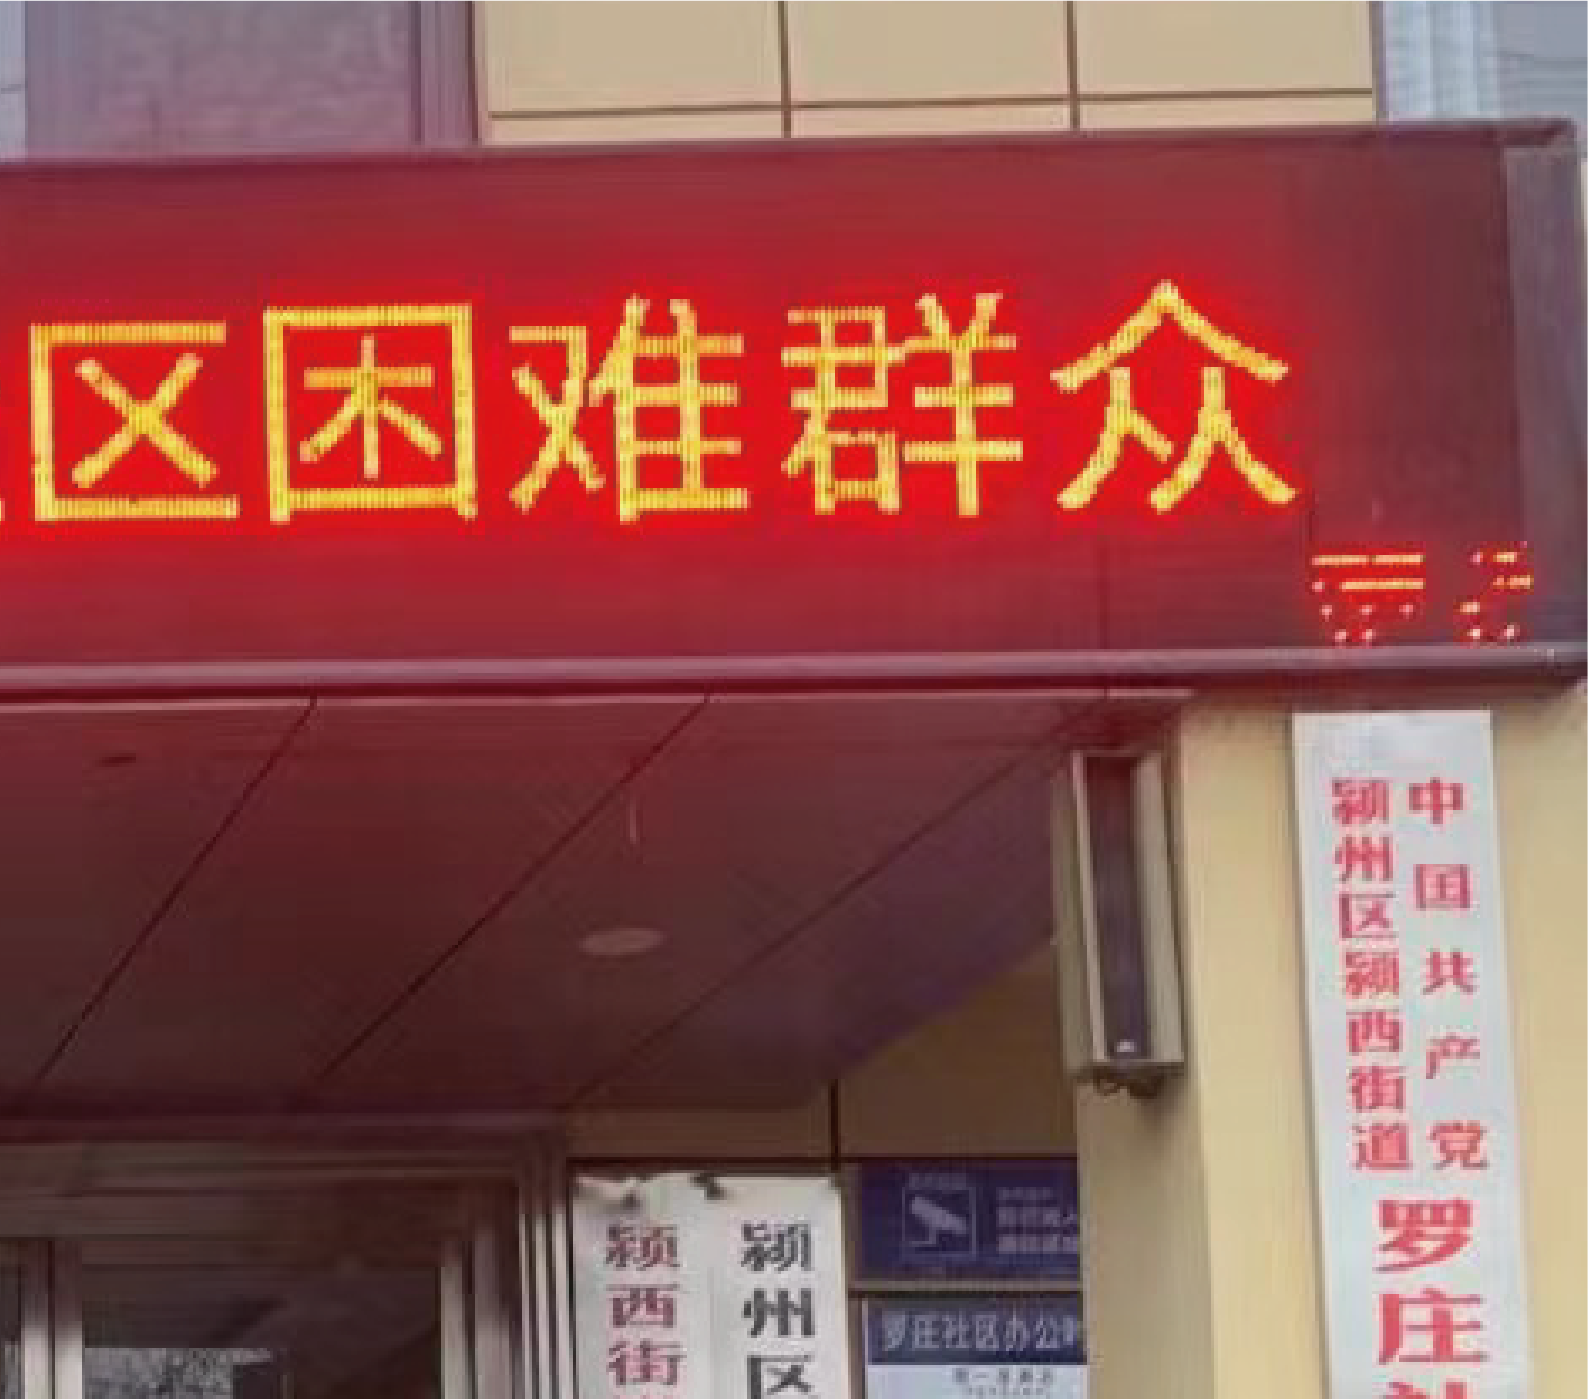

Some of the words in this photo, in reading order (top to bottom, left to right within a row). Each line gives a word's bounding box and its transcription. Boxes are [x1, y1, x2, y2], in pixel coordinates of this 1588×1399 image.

[1406, 776, 1492, 1172] 中国共产党
